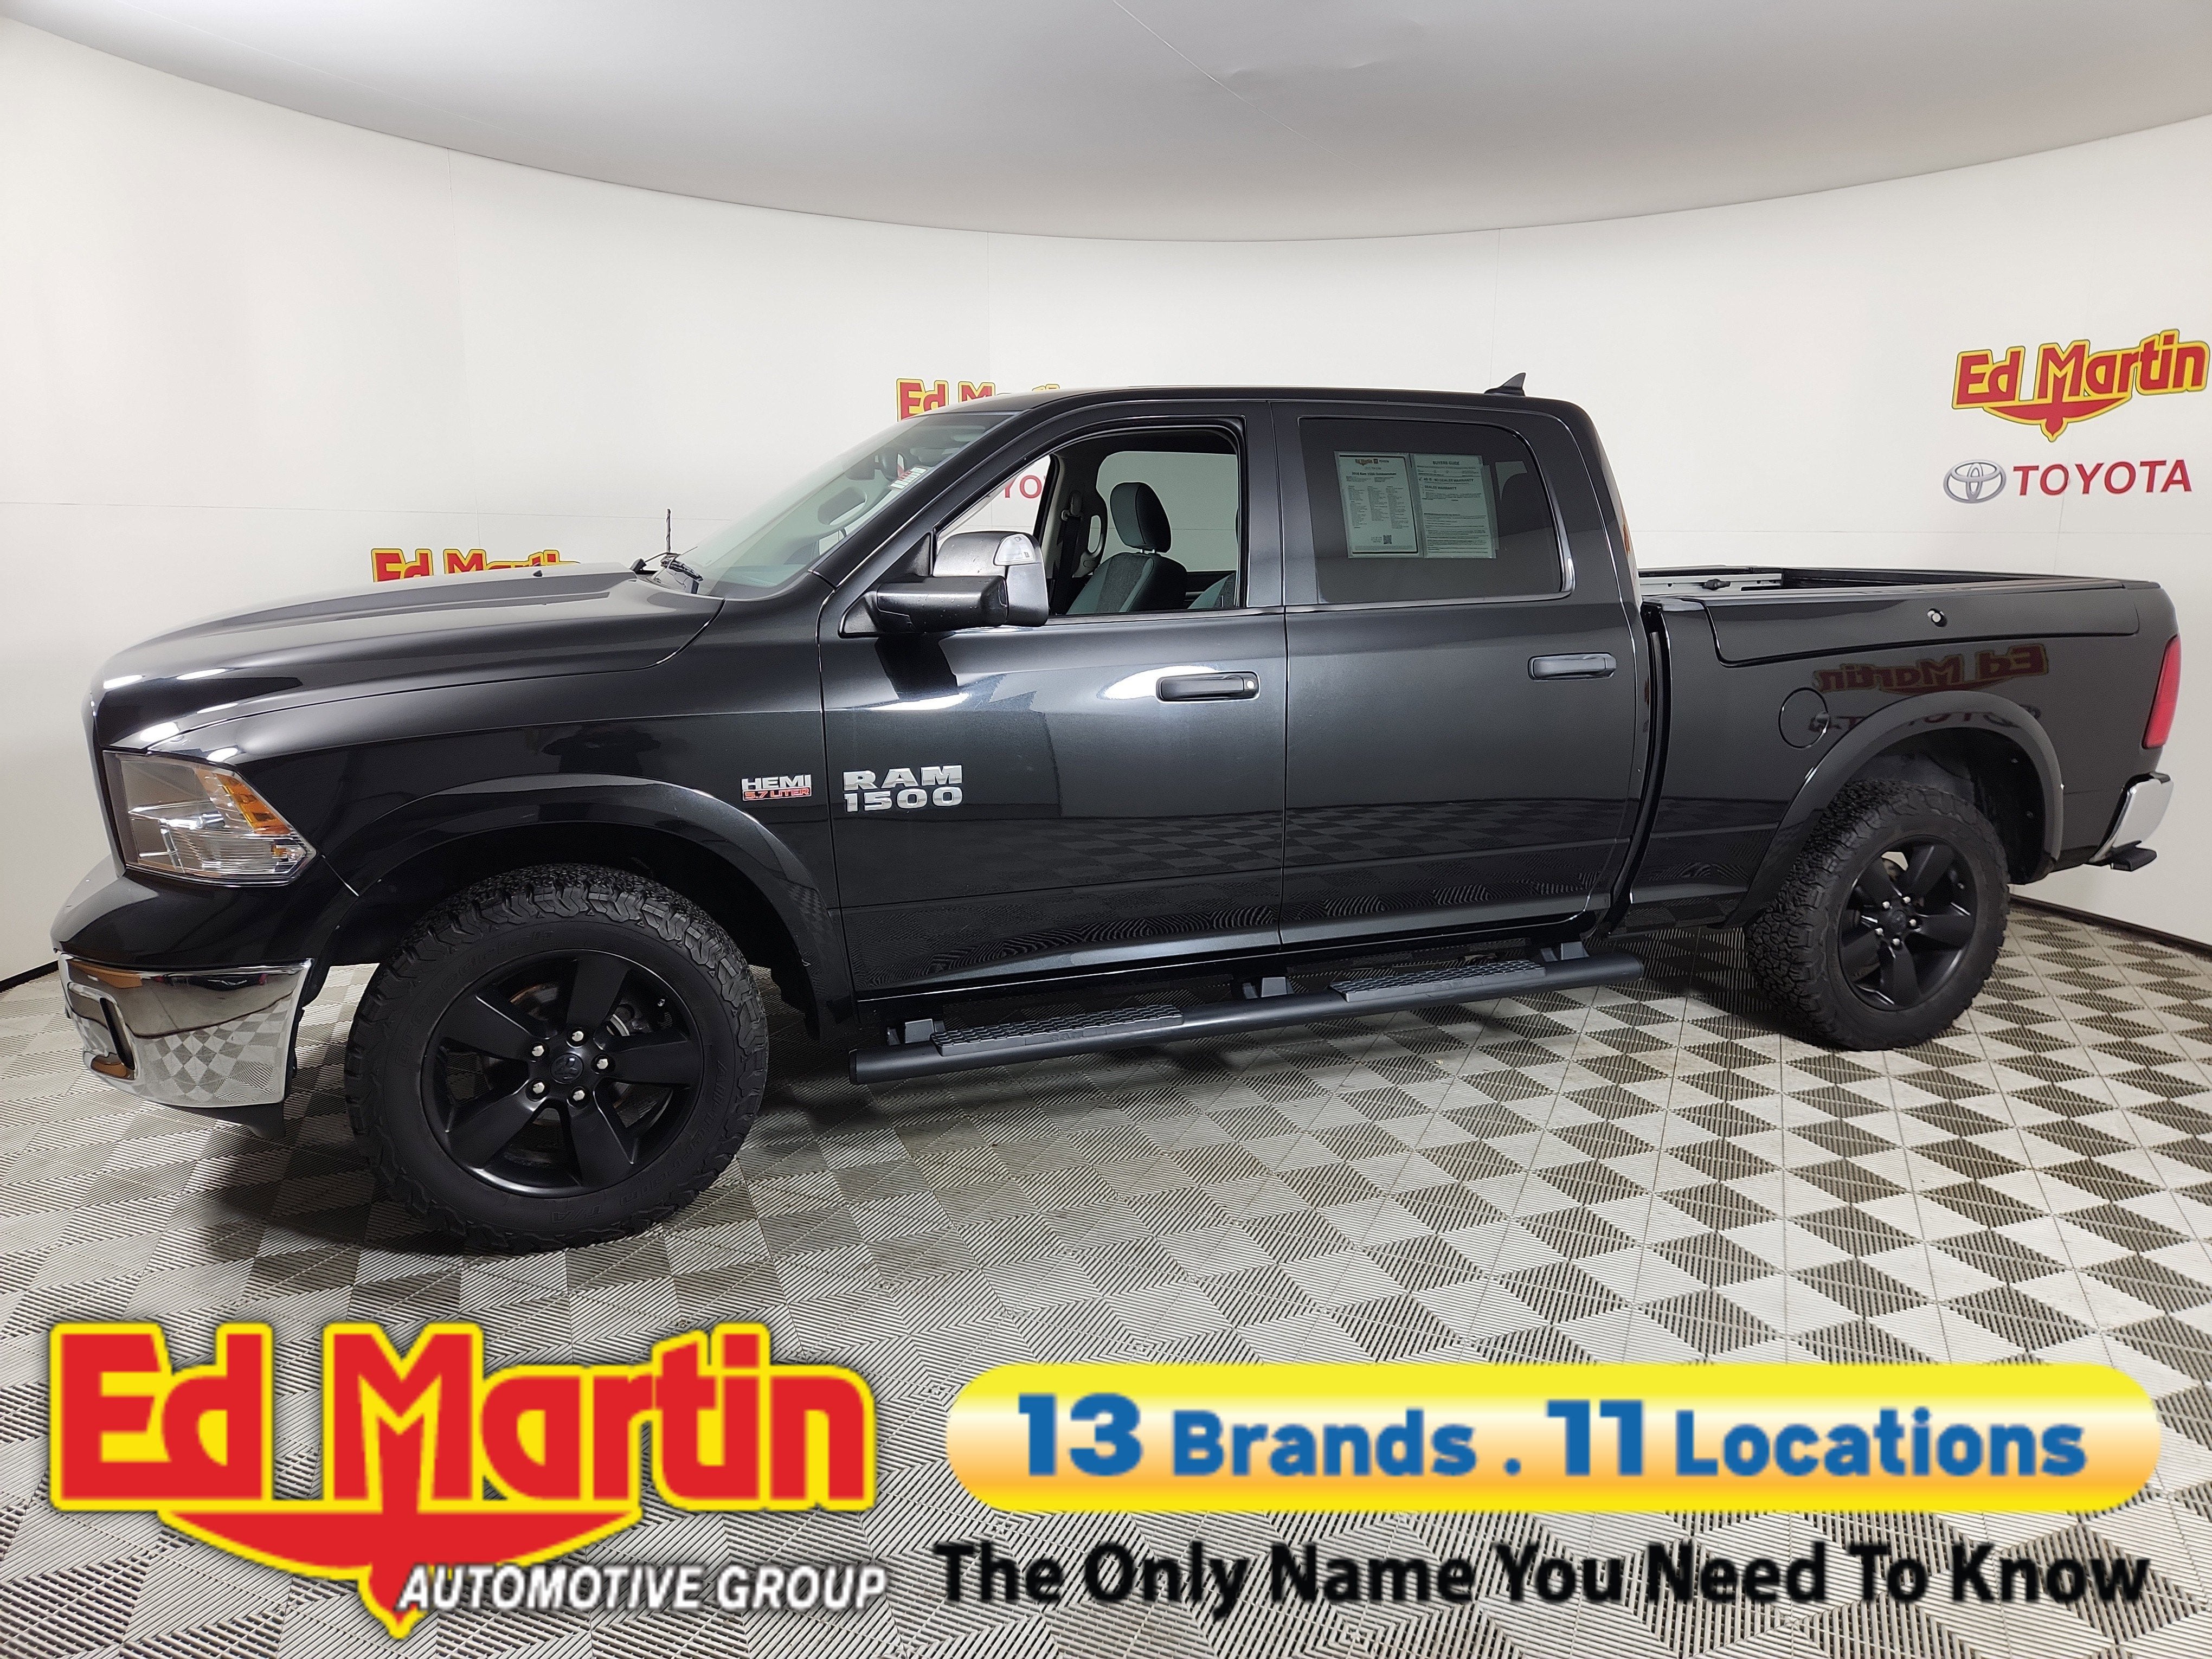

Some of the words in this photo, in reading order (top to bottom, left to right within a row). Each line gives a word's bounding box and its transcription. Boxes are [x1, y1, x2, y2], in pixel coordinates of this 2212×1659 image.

[1952, 346, 2025, 409] Ed
[2033, 329, 2210, 404] Martin
[2012, 459, 2192, 496] TOYOTA
[741, 774, 812, 790] HEMI
[843, 765, 963, 791] RAM
[743, 790, 768, 800] 5.7
[770, 788, 811, 798] LITER
[844, 786, 963, 812] 1500
